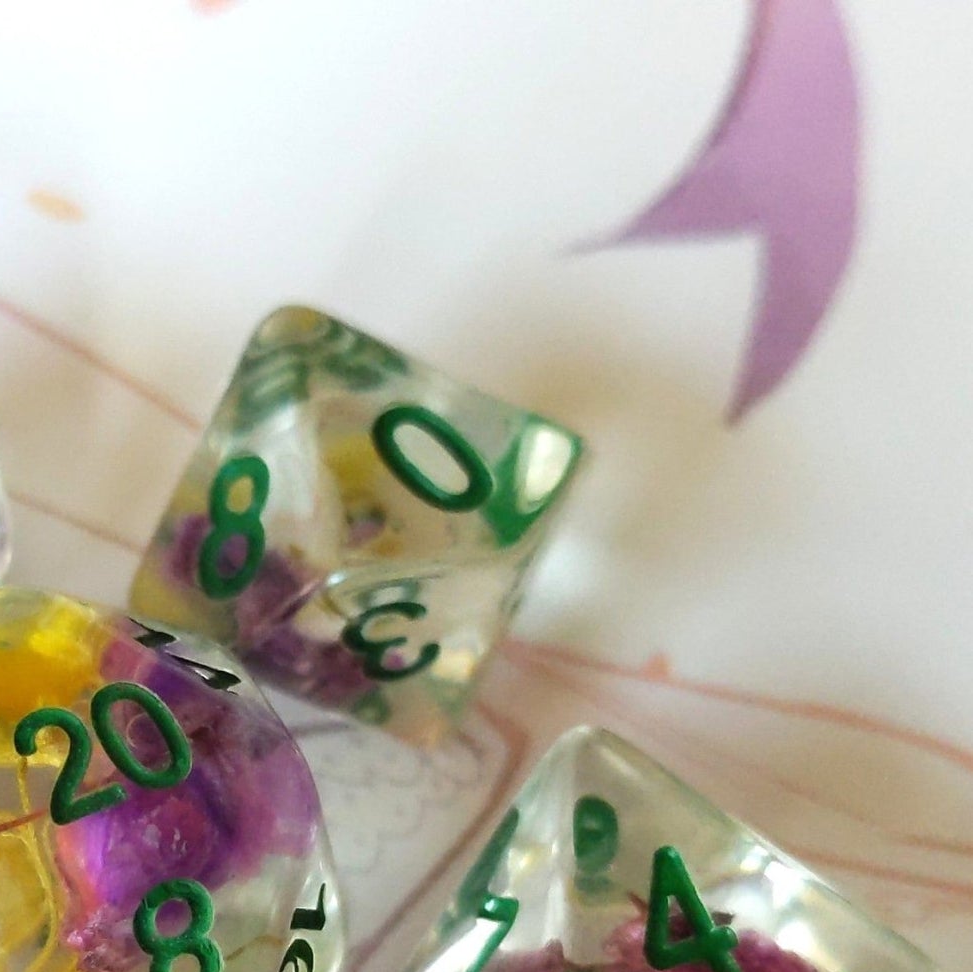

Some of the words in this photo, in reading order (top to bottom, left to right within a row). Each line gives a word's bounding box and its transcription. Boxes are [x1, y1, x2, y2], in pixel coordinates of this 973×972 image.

[371, 405, 493, 514] 0
[197, 454, 270, 601] 8
[342, 601, 441, 682] 3
[14, 681, 192, 826] 20
